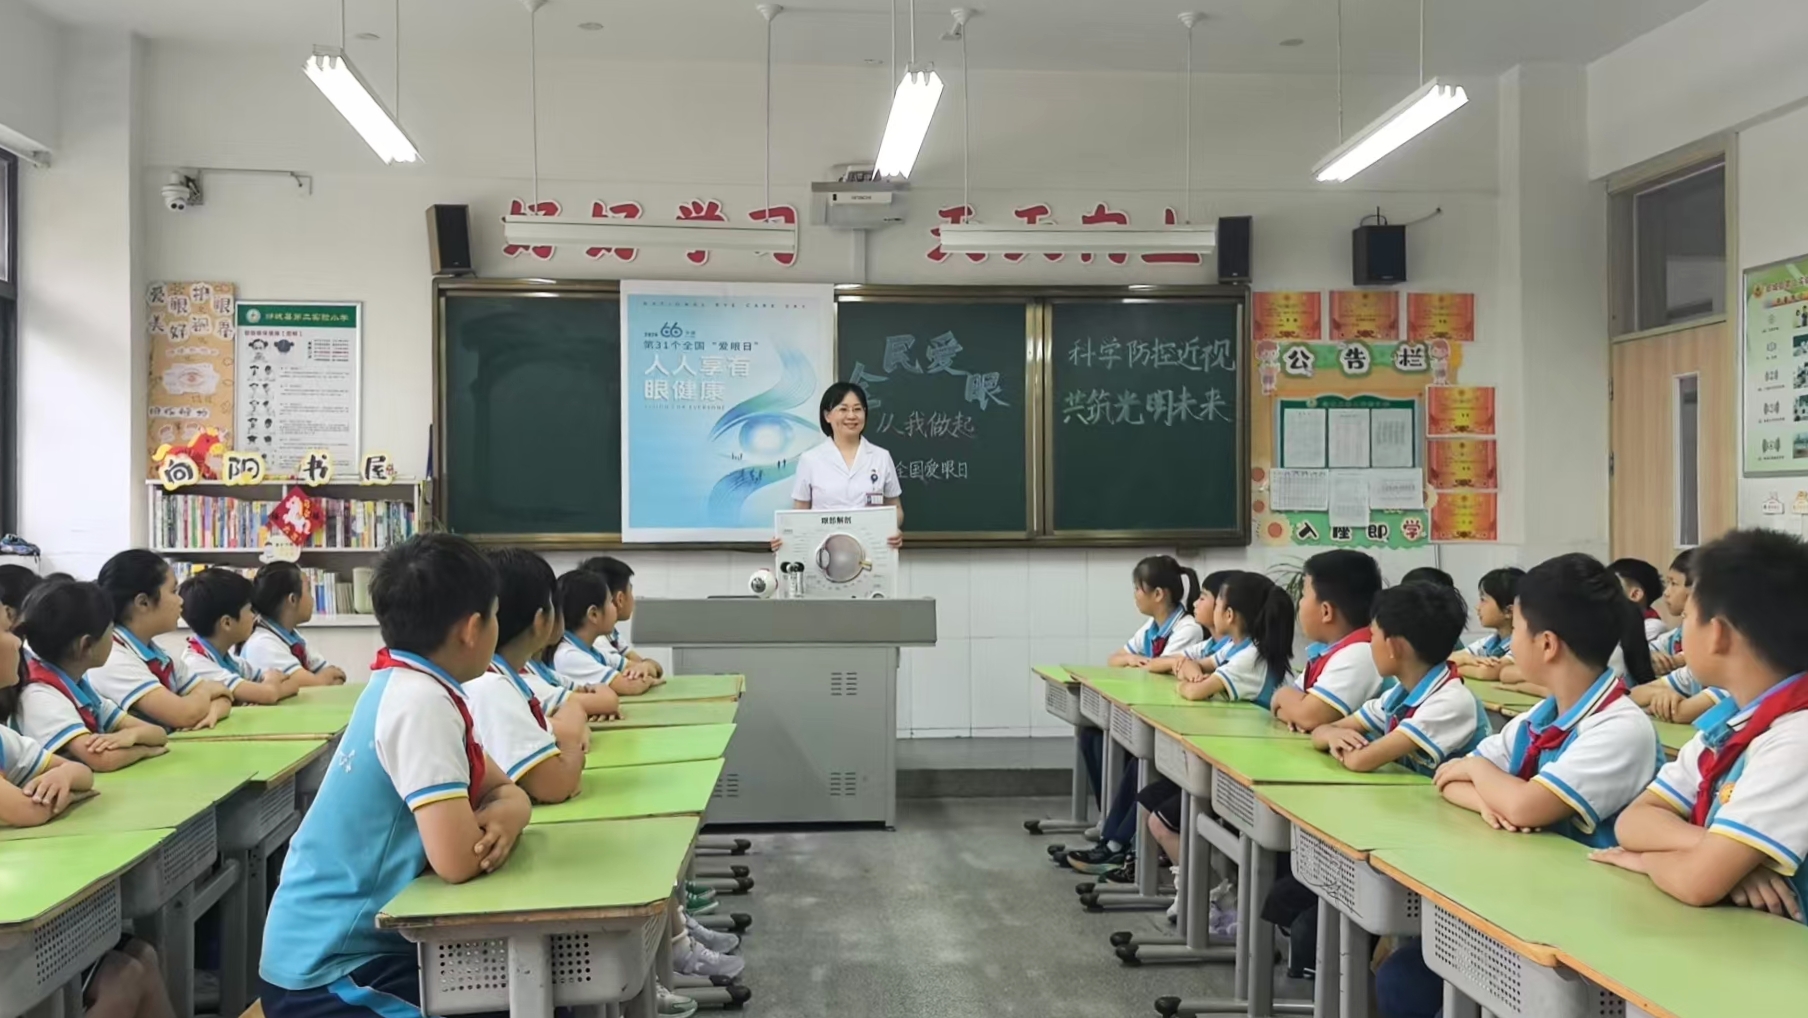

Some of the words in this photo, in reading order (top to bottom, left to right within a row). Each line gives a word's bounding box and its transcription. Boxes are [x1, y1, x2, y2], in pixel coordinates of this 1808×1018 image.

[644, 354, 750, 377] 人人享有
[1068, 335, 1236, 373] 科学防控近视
[1288, 347, 1424, 370] 公告栏
[644, 380, 725, 401] 眼健康
[1063, 385, 1232, 427] 共筑光明未来
[876, 411, 976, 439] 从我做起
[164, 455, 387, 483] 向阳书屋
